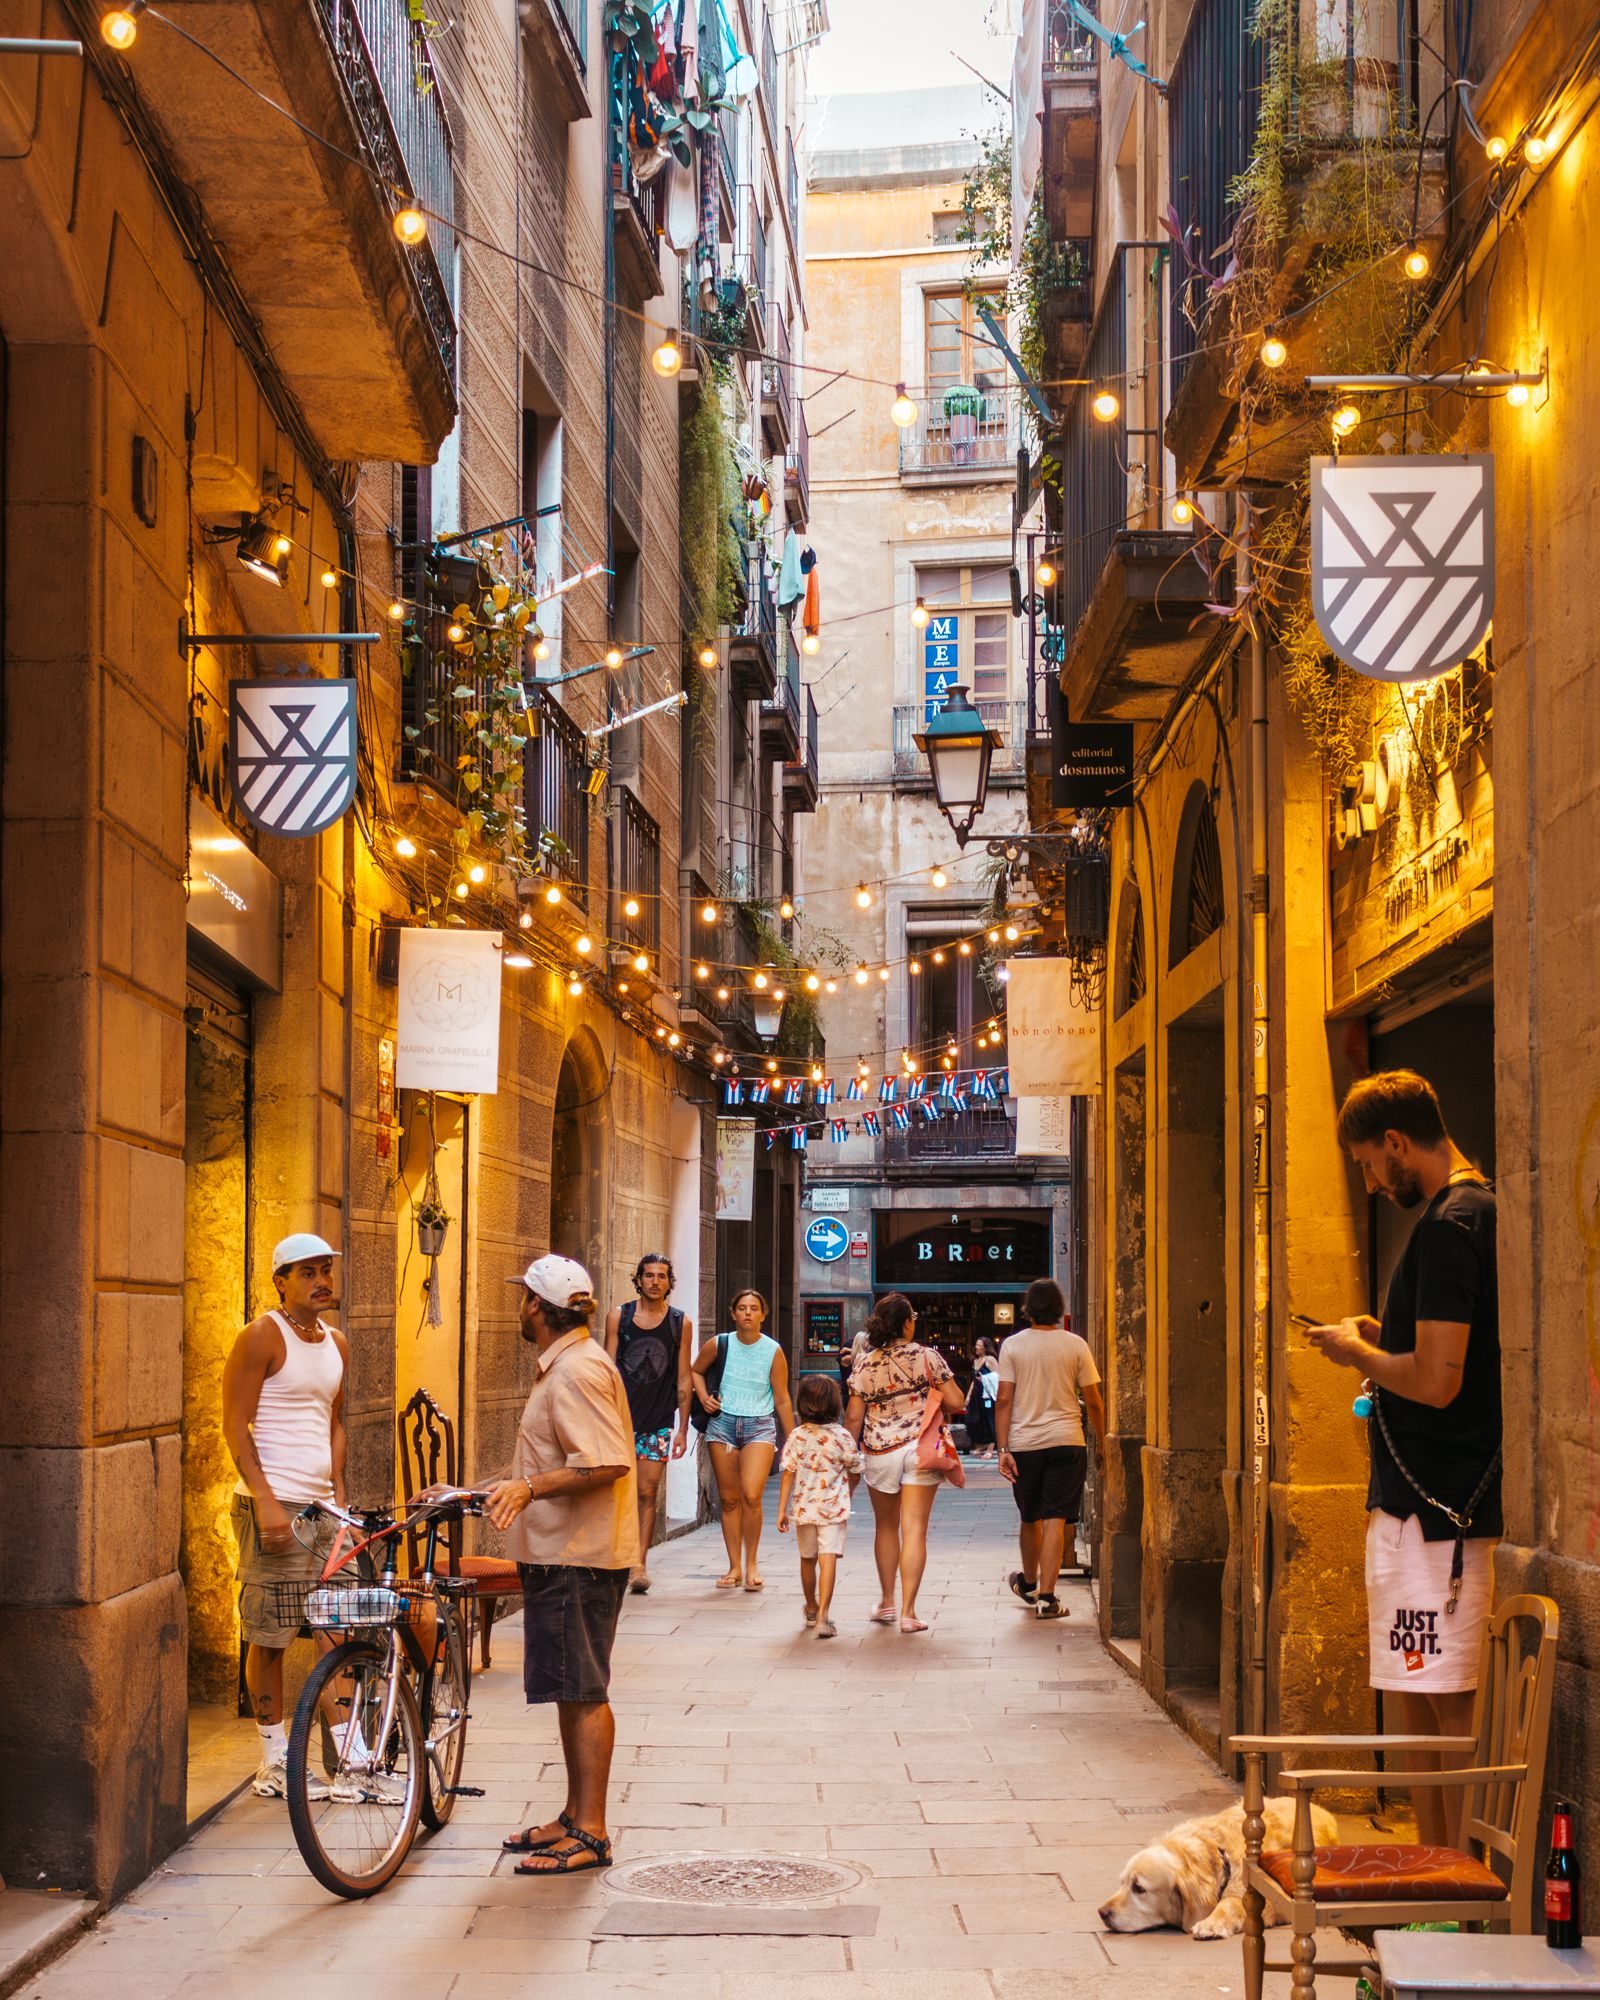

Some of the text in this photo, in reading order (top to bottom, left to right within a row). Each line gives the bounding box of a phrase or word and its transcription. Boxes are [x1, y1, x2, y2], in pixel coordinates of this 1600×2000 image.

[1071, 747, 1113, 758] editorial
[1059, 763, 1126, 776] dosmanos
[400, 1044, 435, 1055] MARINA
[1059, 1241, 1068, 1255] 3
[1393, 1608, 1438, 1632] JUST
[1389, 1629, 1442, 1655] DO IT.
